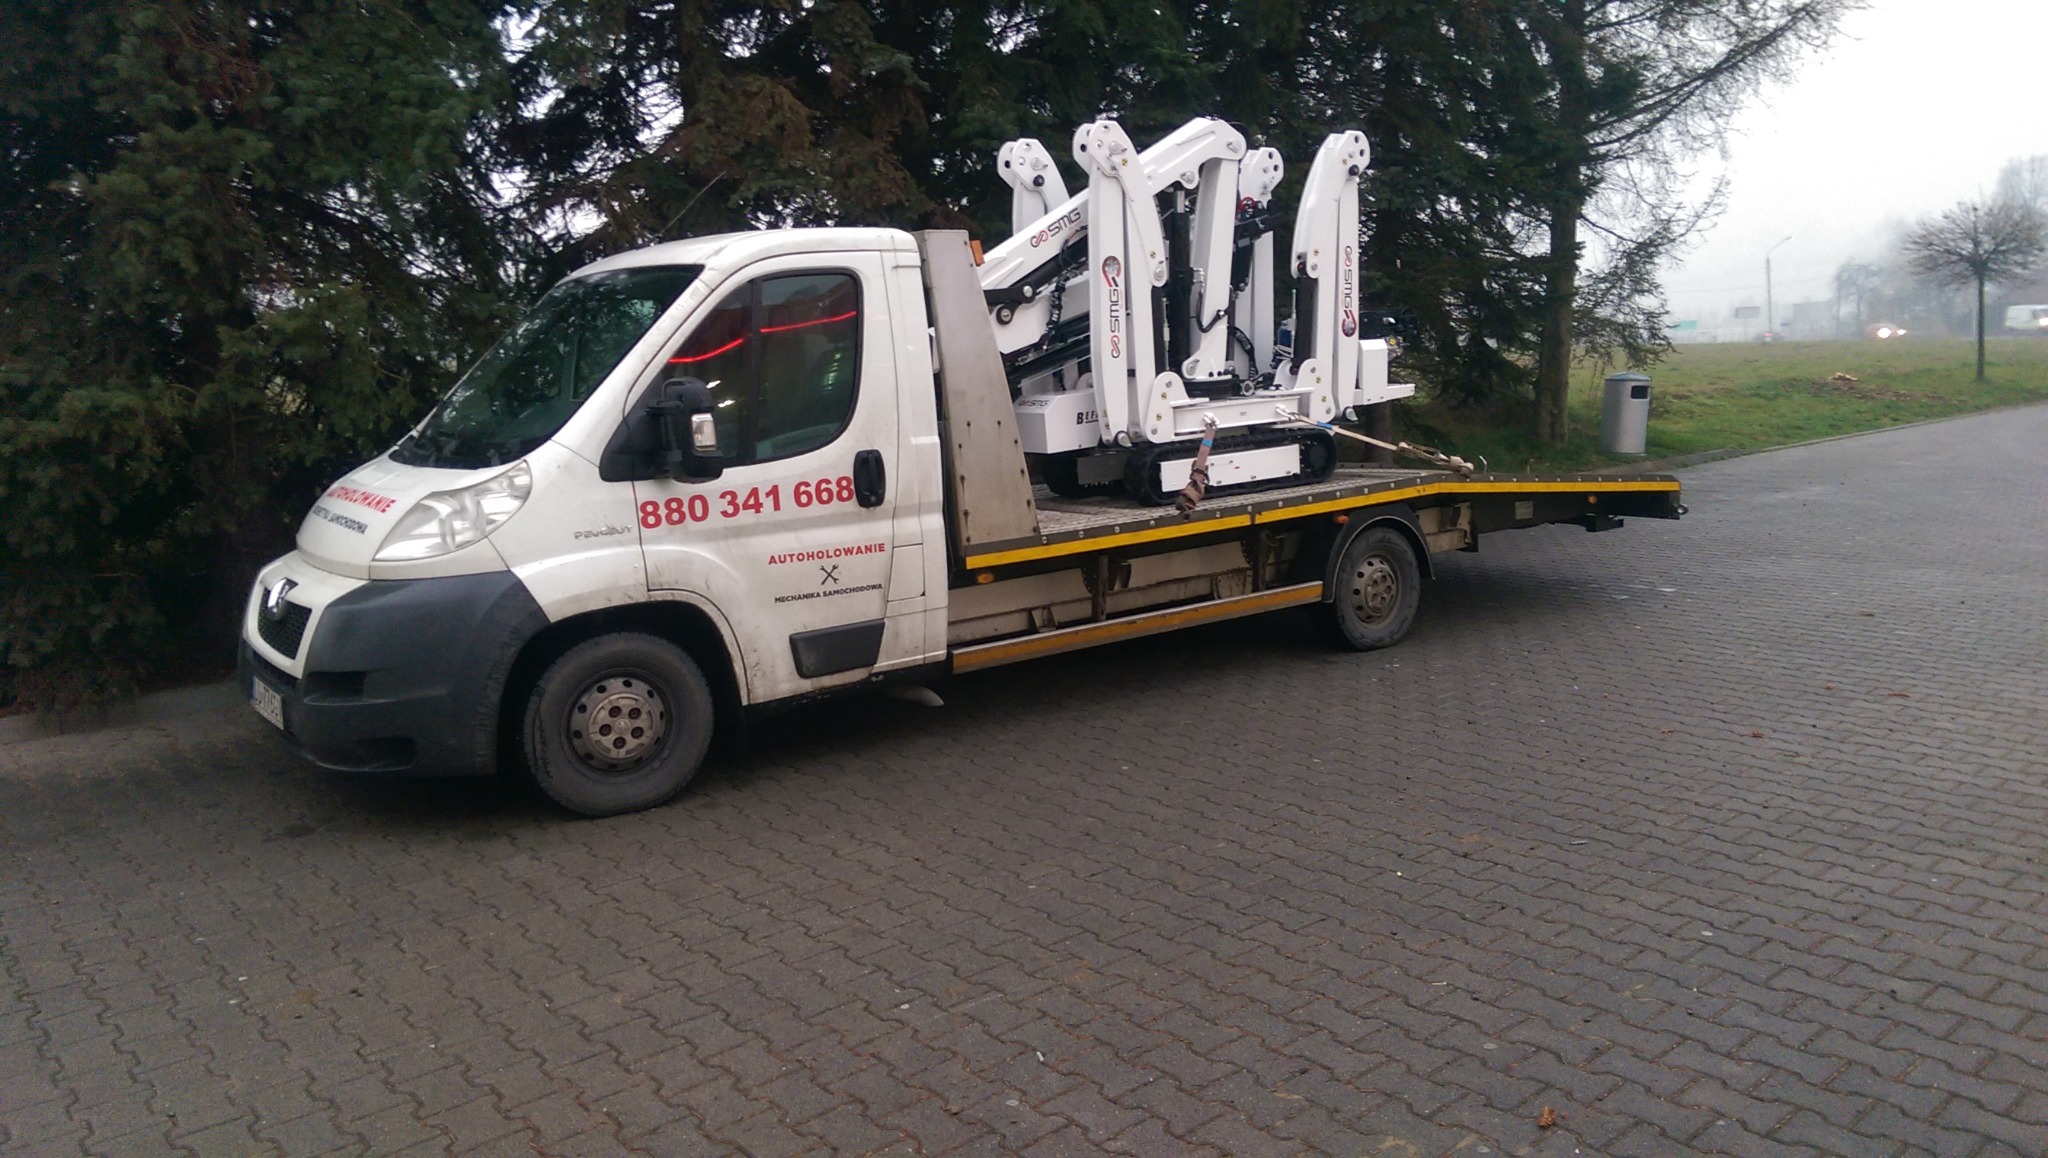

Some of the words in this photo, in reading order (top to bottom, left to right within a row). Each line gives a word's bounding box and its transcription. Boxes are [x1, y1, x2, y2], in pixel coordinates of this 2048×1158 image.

[1048, 207, 1081, 237] SMG
[1344, 269, 1352, 308] SMG
[1109, 288, 1120, 333] SMG
[640, 494, 709, 529] 880
[719, 485, 781, 518] 341
[793, 476, 855, 508] 668
[574, 525, 632, 539] PEUGEOT
[768, 543, 886, 565] AUTOHOLOWANIE
[774, 591, 821, 603] MECHANIKA
[822, 583, 883, 597] SAMOCHODOWA
